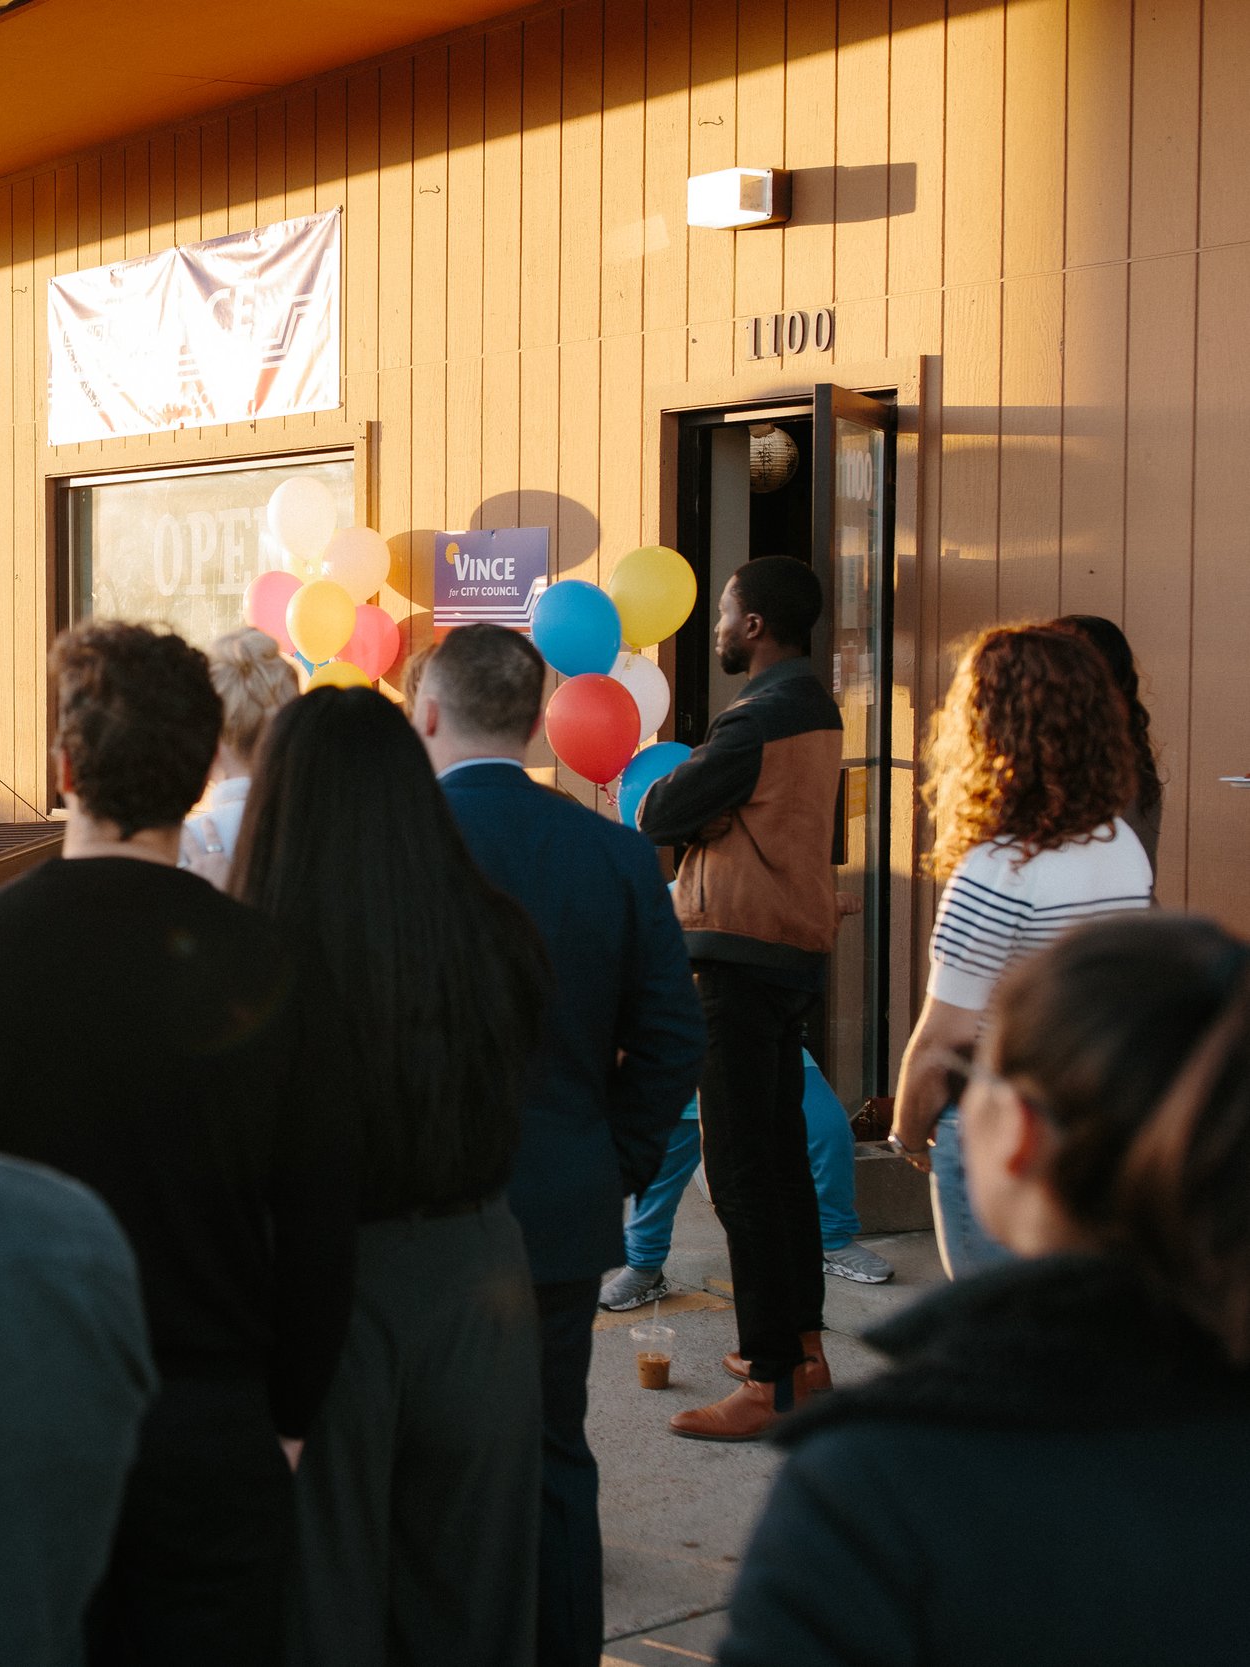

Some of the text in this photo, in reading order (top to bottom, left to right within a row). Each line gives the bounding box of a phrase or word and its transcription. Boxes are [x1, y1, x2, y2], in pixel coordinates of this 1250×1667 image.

[746, 308, 831, 361] 1100
[453, 553, 516, 581] VINCE
[448, 586, 520, 599] for CITY COUNCIL
